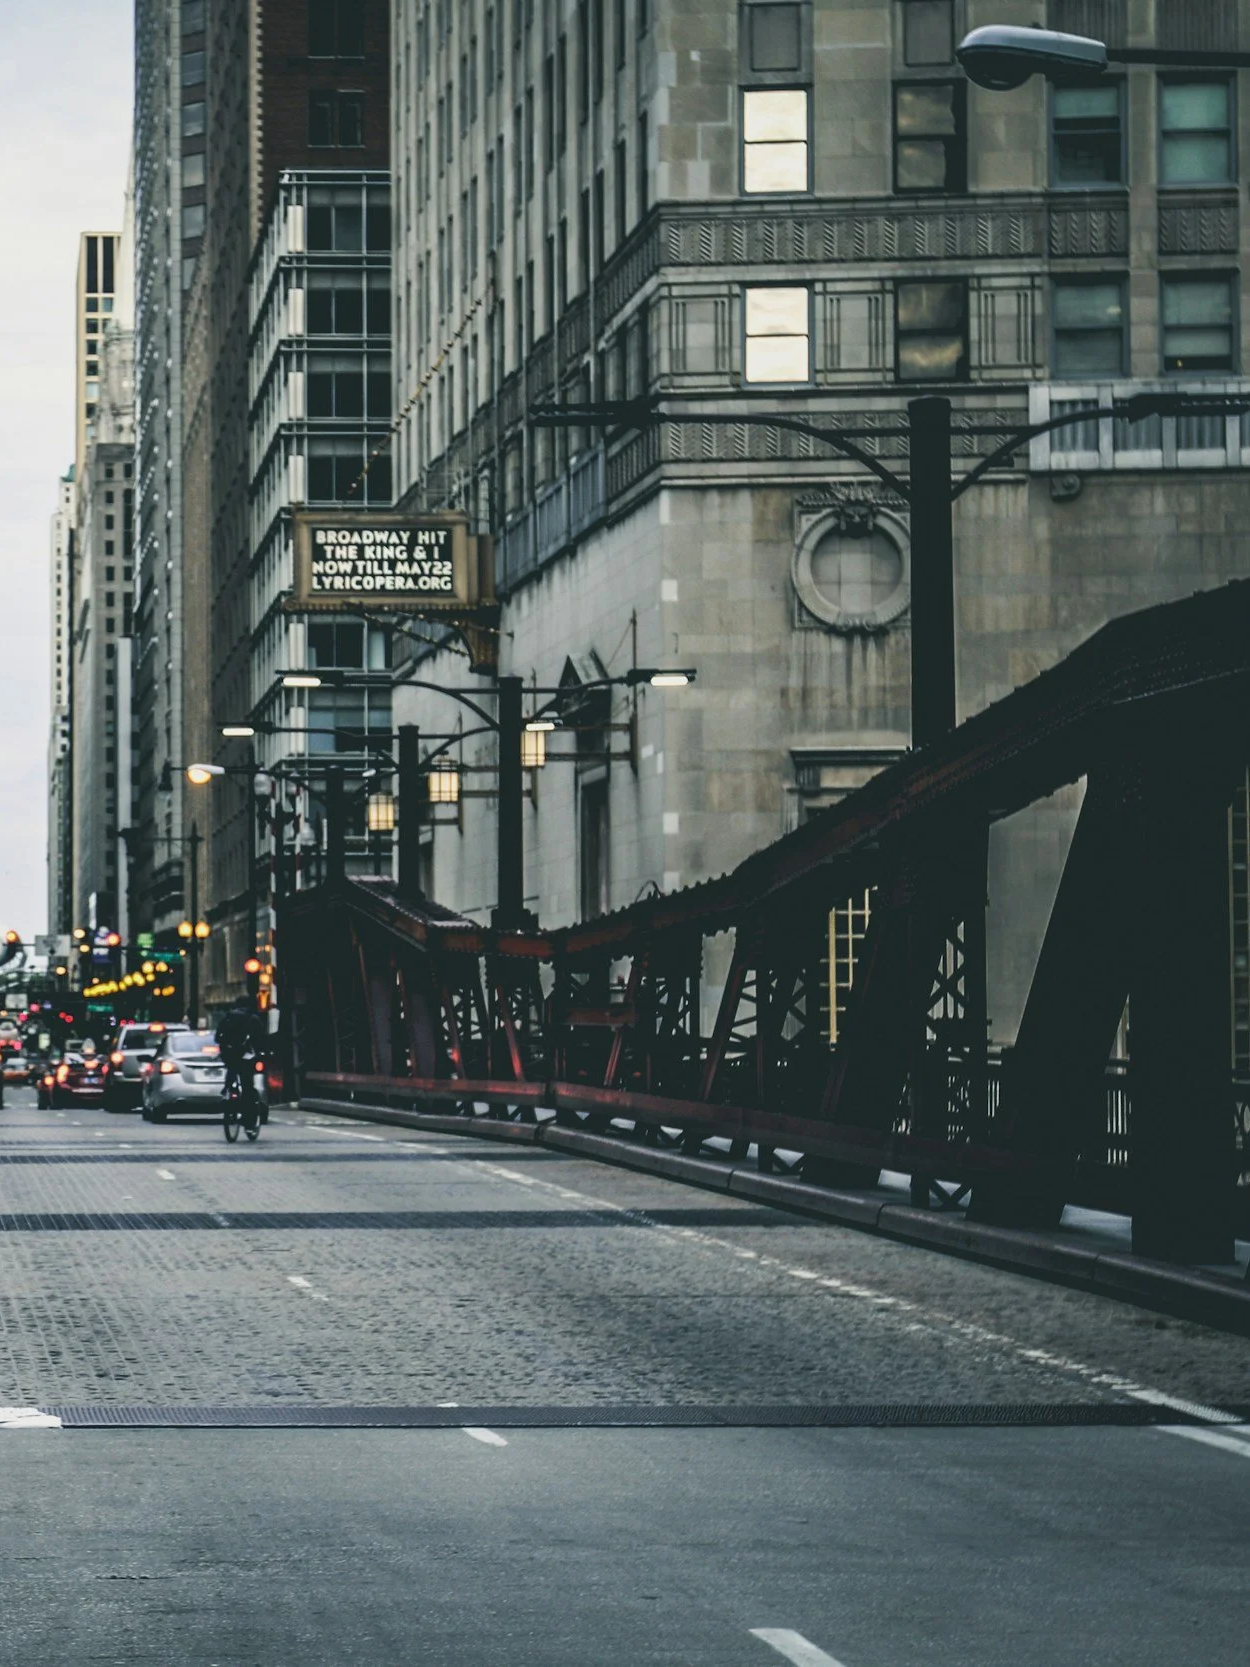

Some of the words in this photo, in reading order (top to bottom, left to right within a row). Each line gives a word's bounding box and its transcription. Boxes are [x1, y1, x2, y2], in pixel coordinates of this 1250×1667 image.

[315, 530, 410, 545] BROADWAY
[417, 530, 447, 545] HIT
[323, 545, 358, 560] THE
[364, 545, 408, 560] KING
[412, 545, 427, 560] &
[433, 546, 439, 560] I
[312, 560, 353, 575] NOW
[355, 560, 393, 575] TILL
[312, 575, 452, 590] LYRICOPERA.ORG
